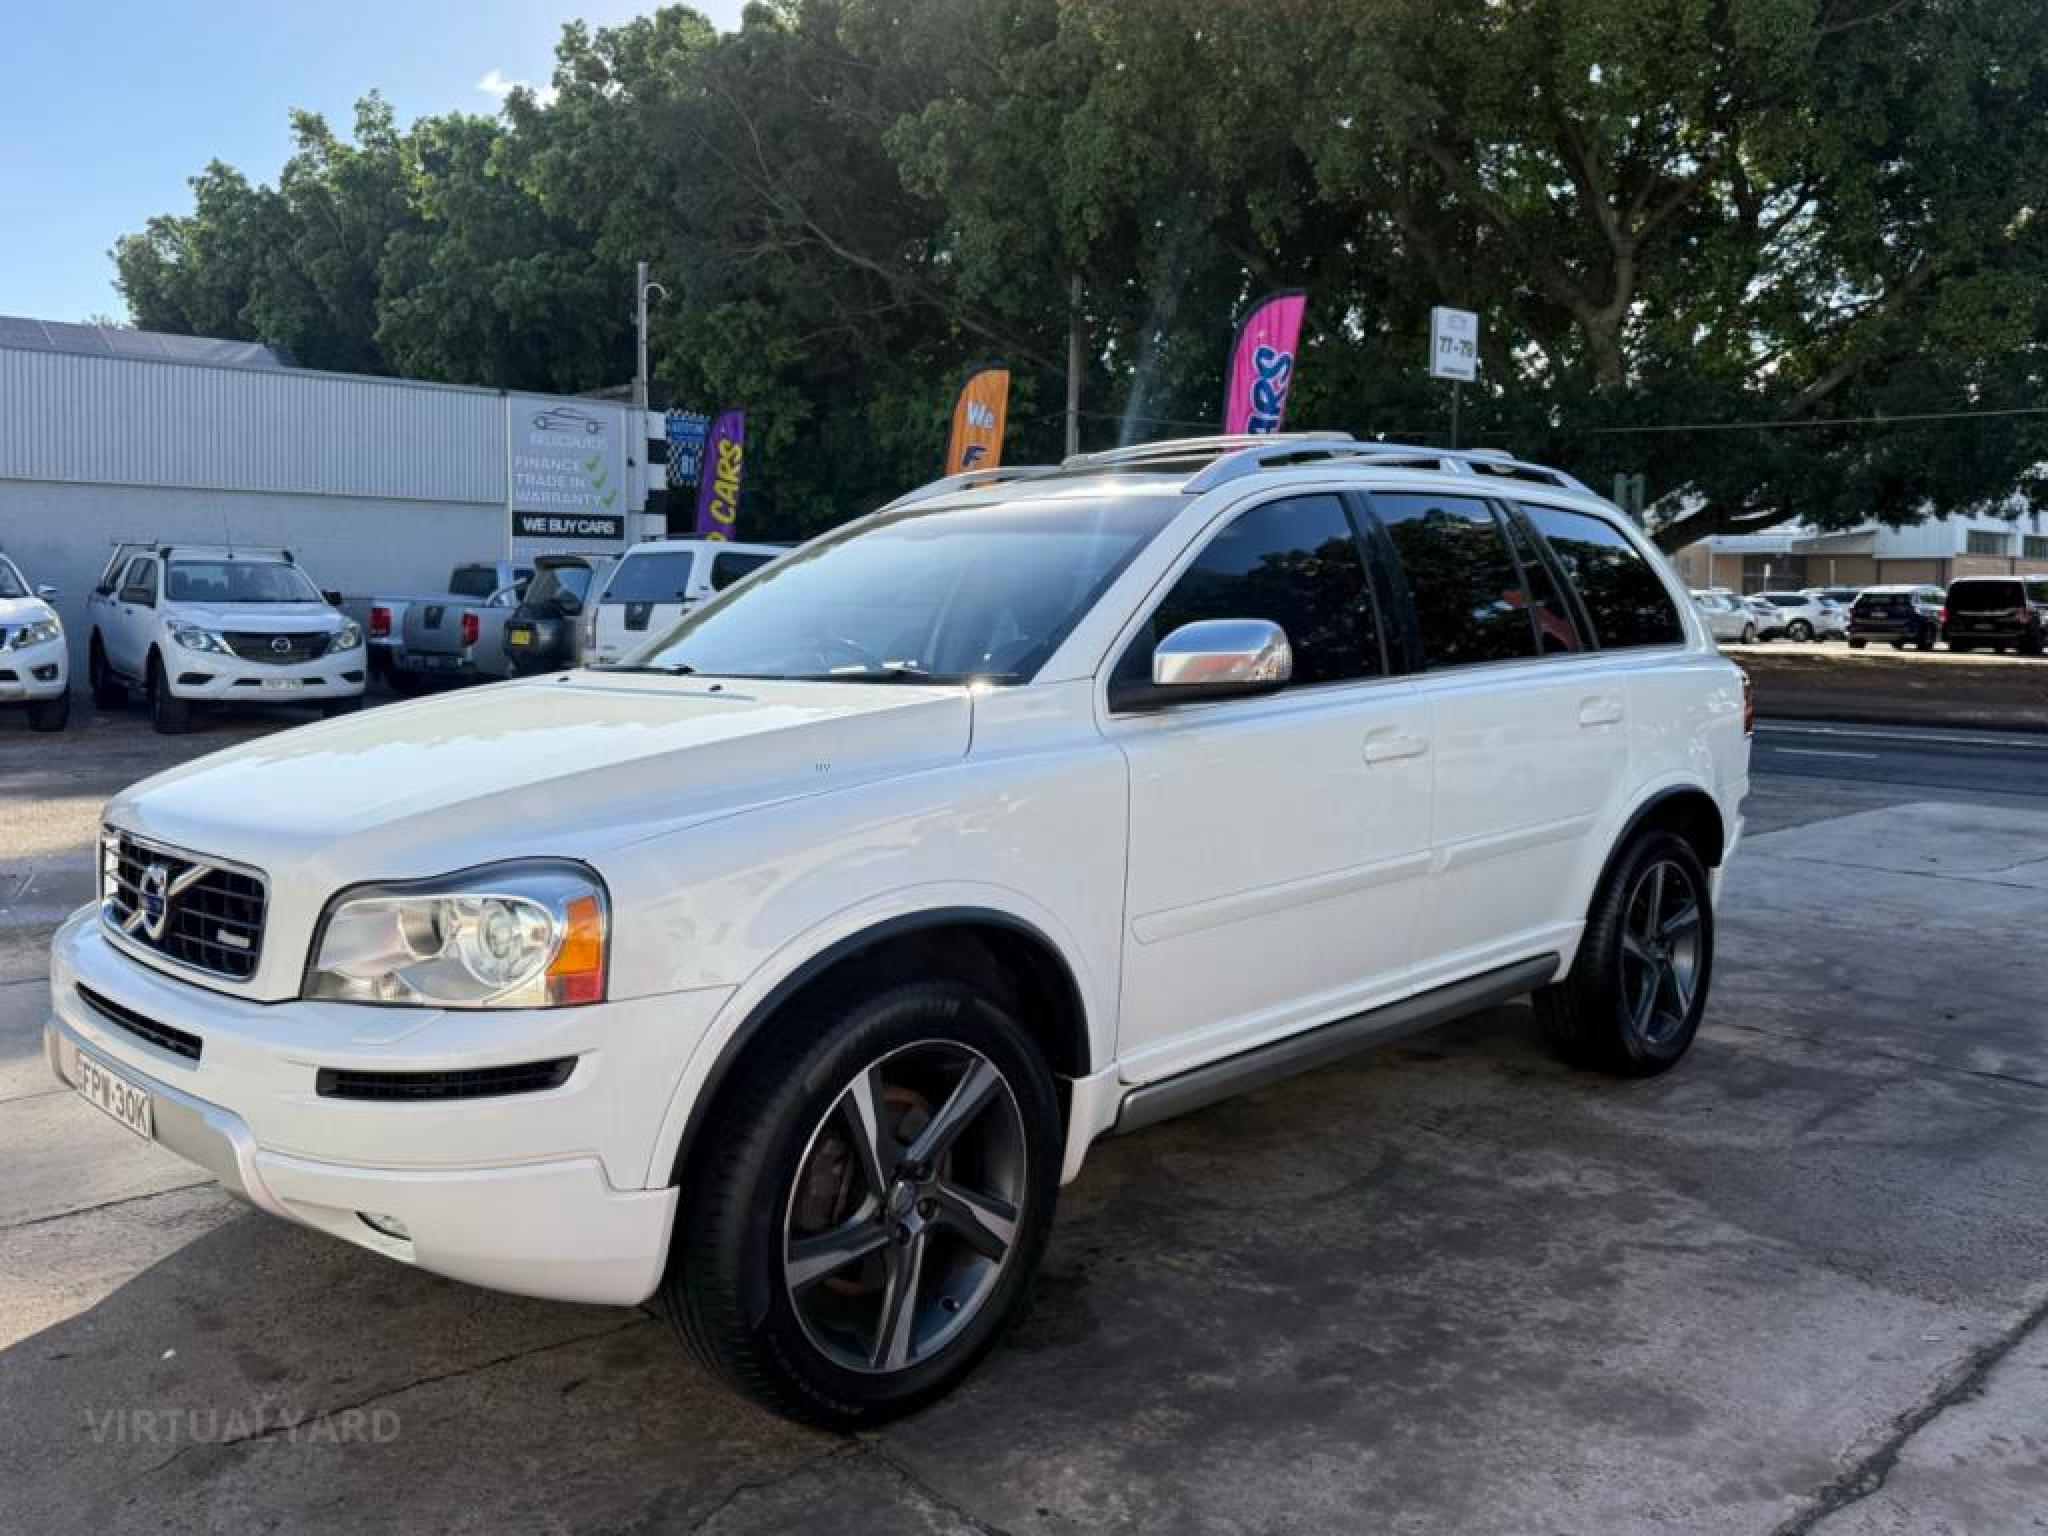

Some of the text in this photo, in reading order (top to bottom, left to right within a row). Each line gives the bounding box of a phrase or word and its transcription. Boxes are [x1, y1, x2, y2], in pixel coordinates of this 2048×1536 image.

[967, 401, 993, 428] We
[709, 438, 743, 524] CARS
[523, 517, 615, 535] WE BUY CARS
